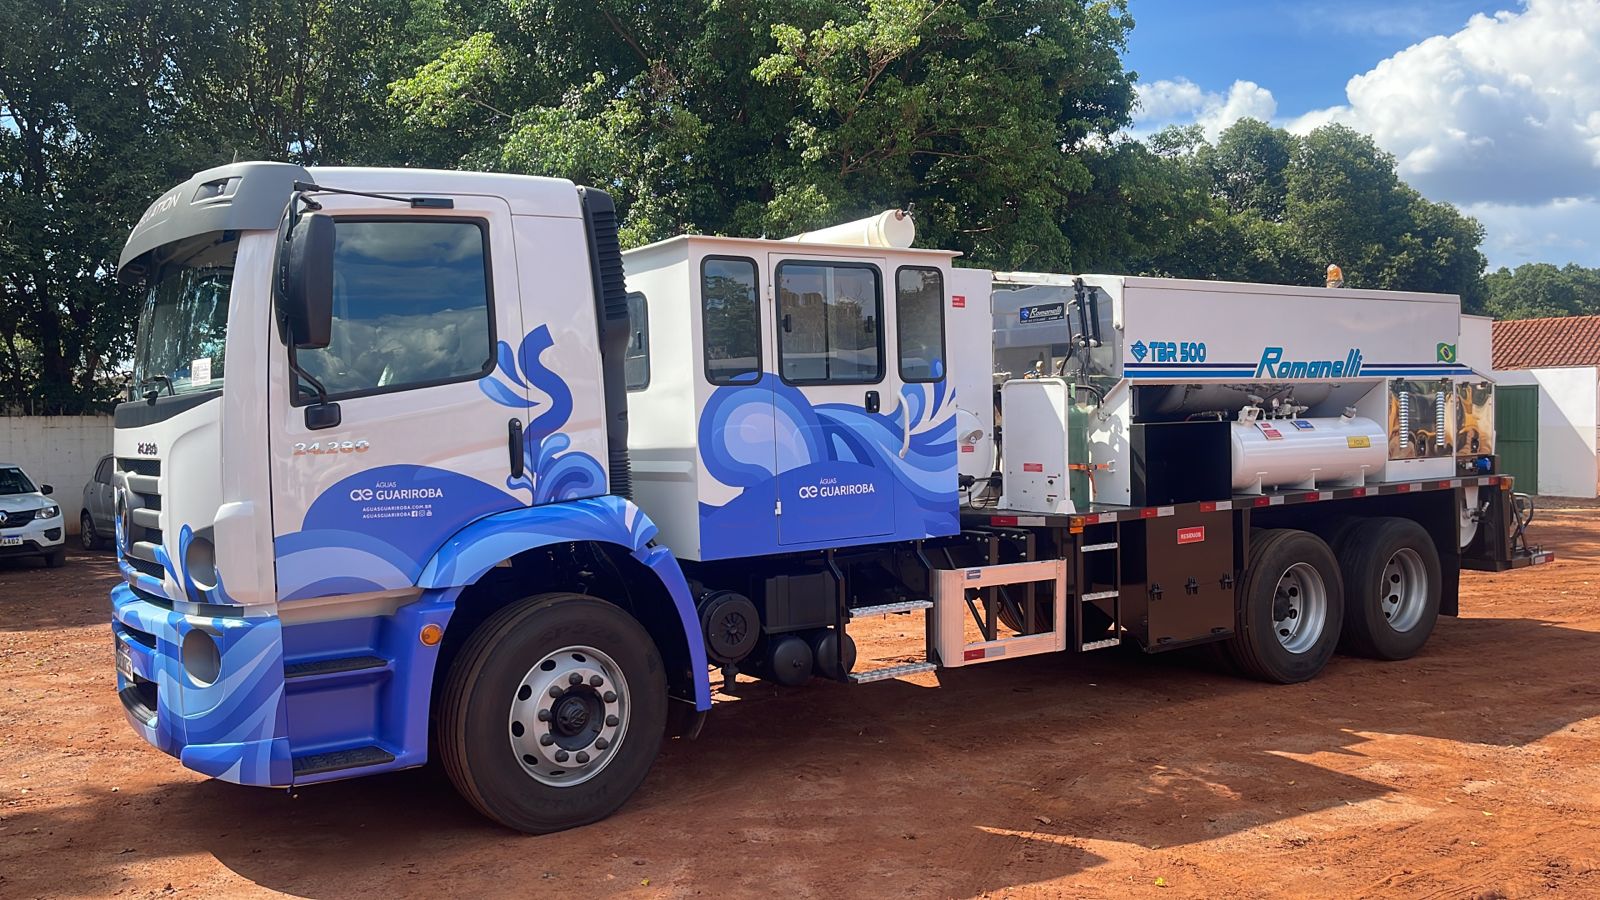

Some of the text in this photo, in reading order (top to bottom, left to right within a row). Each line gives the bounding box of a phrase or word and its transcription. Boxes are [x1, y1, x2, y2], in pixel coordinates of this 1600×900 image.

[1148, 342, 1207, 362] TBR 500
[1255, 346, 1363, 378] Romanelli
[376, 487, 444, 500] GUARIROBA
[820, 483, 875, 498] GUARIROBA
